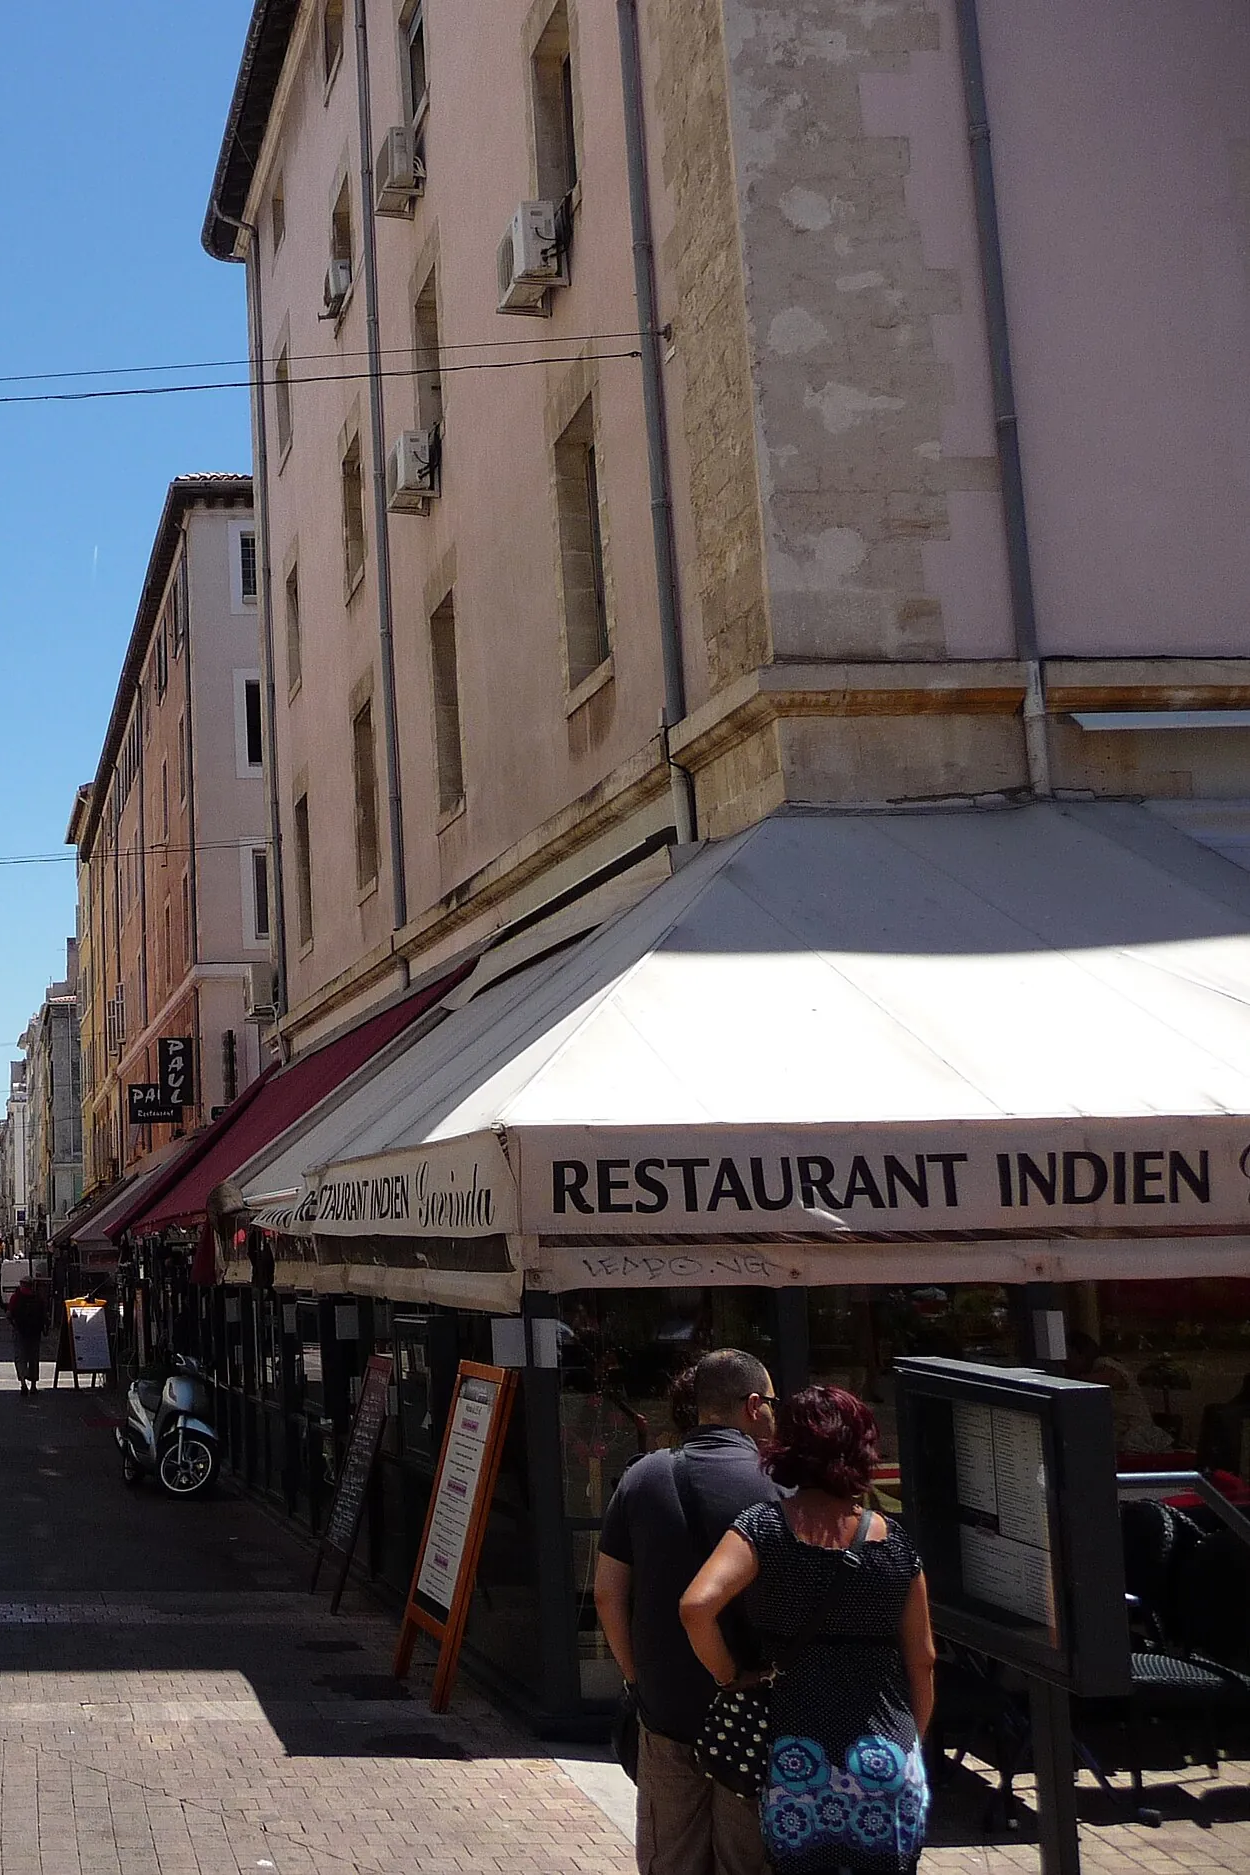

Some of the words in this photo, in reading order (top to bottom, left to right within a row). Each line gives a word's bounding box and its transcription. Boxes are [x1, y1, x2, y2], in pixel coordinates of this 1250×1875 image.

[132, 1088, 161, 1104] PA
[167, 1039, 185, 1105] PAUL
[293, 1180, 369, 1222] RESTAURANT
[369, 1175, 410, 1219] INDIEN
[415, 1161, 496, 1228] Govinda
[552, 1153, 968, 1214] RESTAURANT
[997, 1149, 1210, 1208] INDIEN
